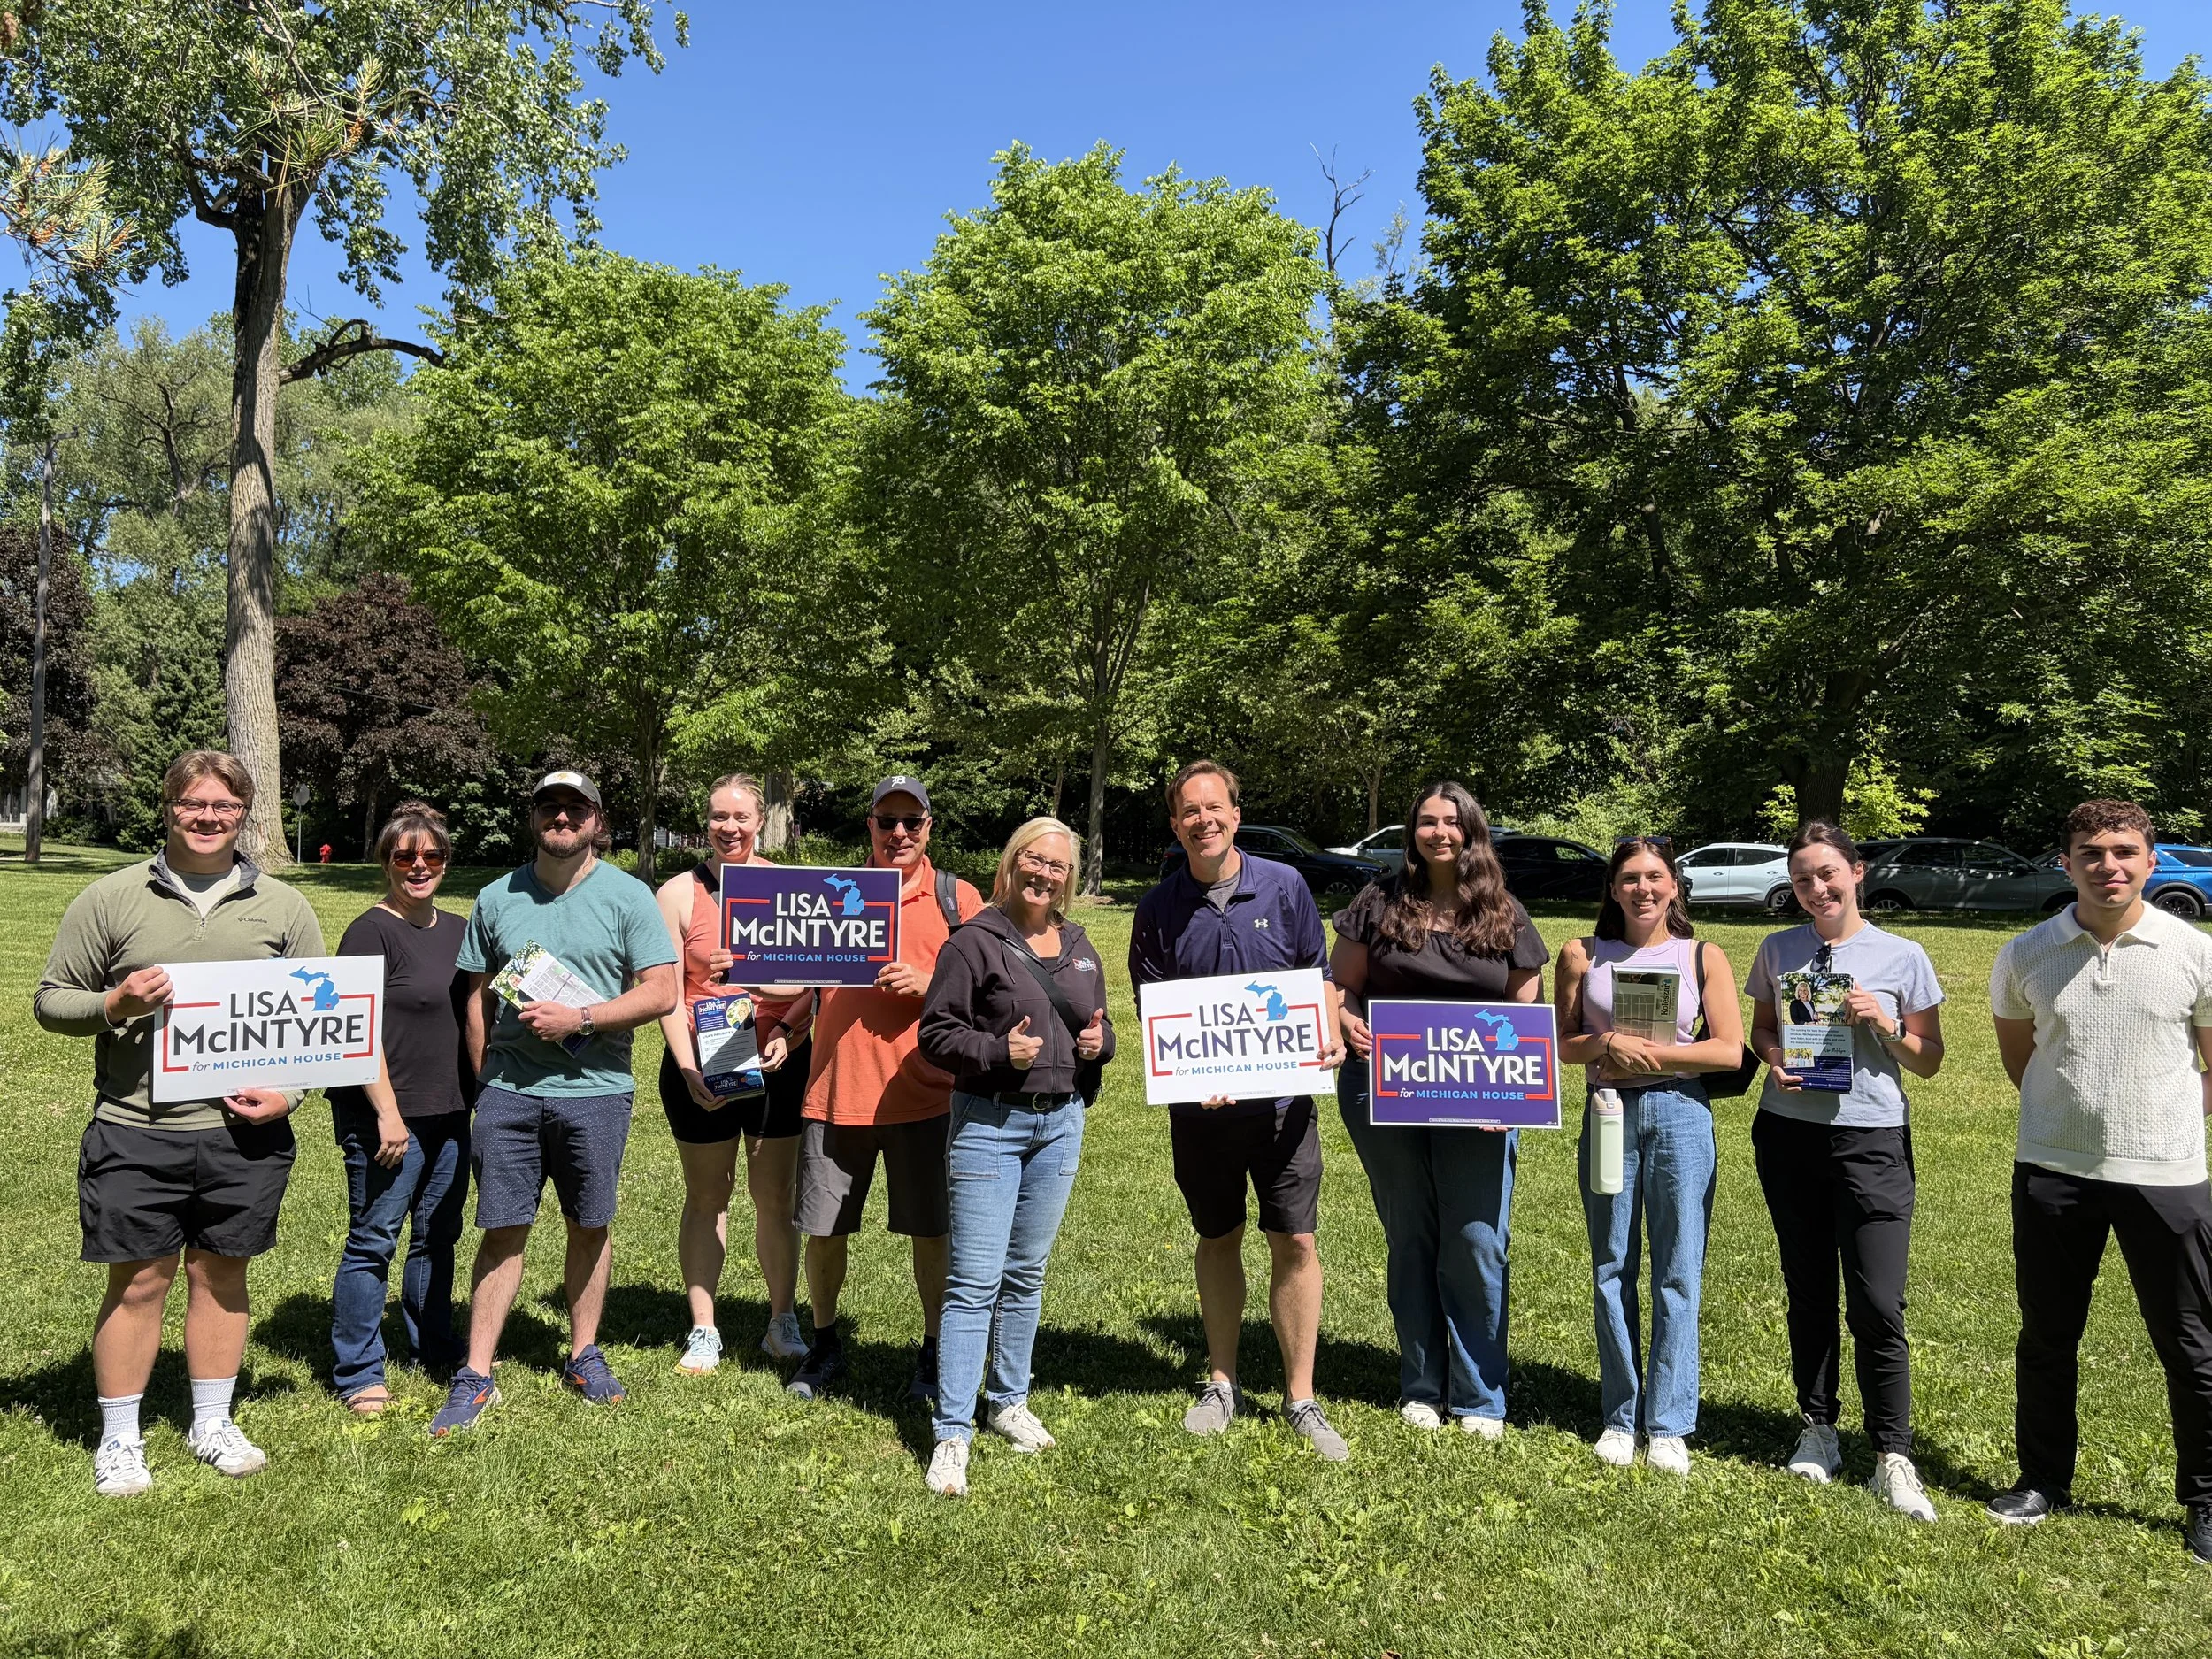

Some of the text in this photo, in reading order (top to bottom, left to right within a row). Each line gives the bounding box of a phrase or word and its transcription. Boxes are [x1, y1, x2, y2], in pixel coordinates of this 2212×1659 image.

[776, 892, 831, 918] LISA
[733, 916, 886, 948] McINTYRE
[747, 951, 866, 963] for MICHIGAN HOUSE
[230, 990, 298, 1018] LISA
[1661, 983, 1670, 1016] Koleszar
[1199, 1002, 1256, 1027] LISA
[173, 1014, 364, 1056] McINTYRE
[1157, 1023, 1315, 1061] McINTYRE
[1427, 1027, 1485, 1052] LISA
[192, 1052, 341, 1071] for MICHIGAN HOUSE
[1175, 1061, 1297, 1076] for MICHIGAN HOUSE
[1384, 1052, 1544, 1085] McINTYRE
[1399, 1087, 1525, 1100] for MICHIGAN HOUSE
